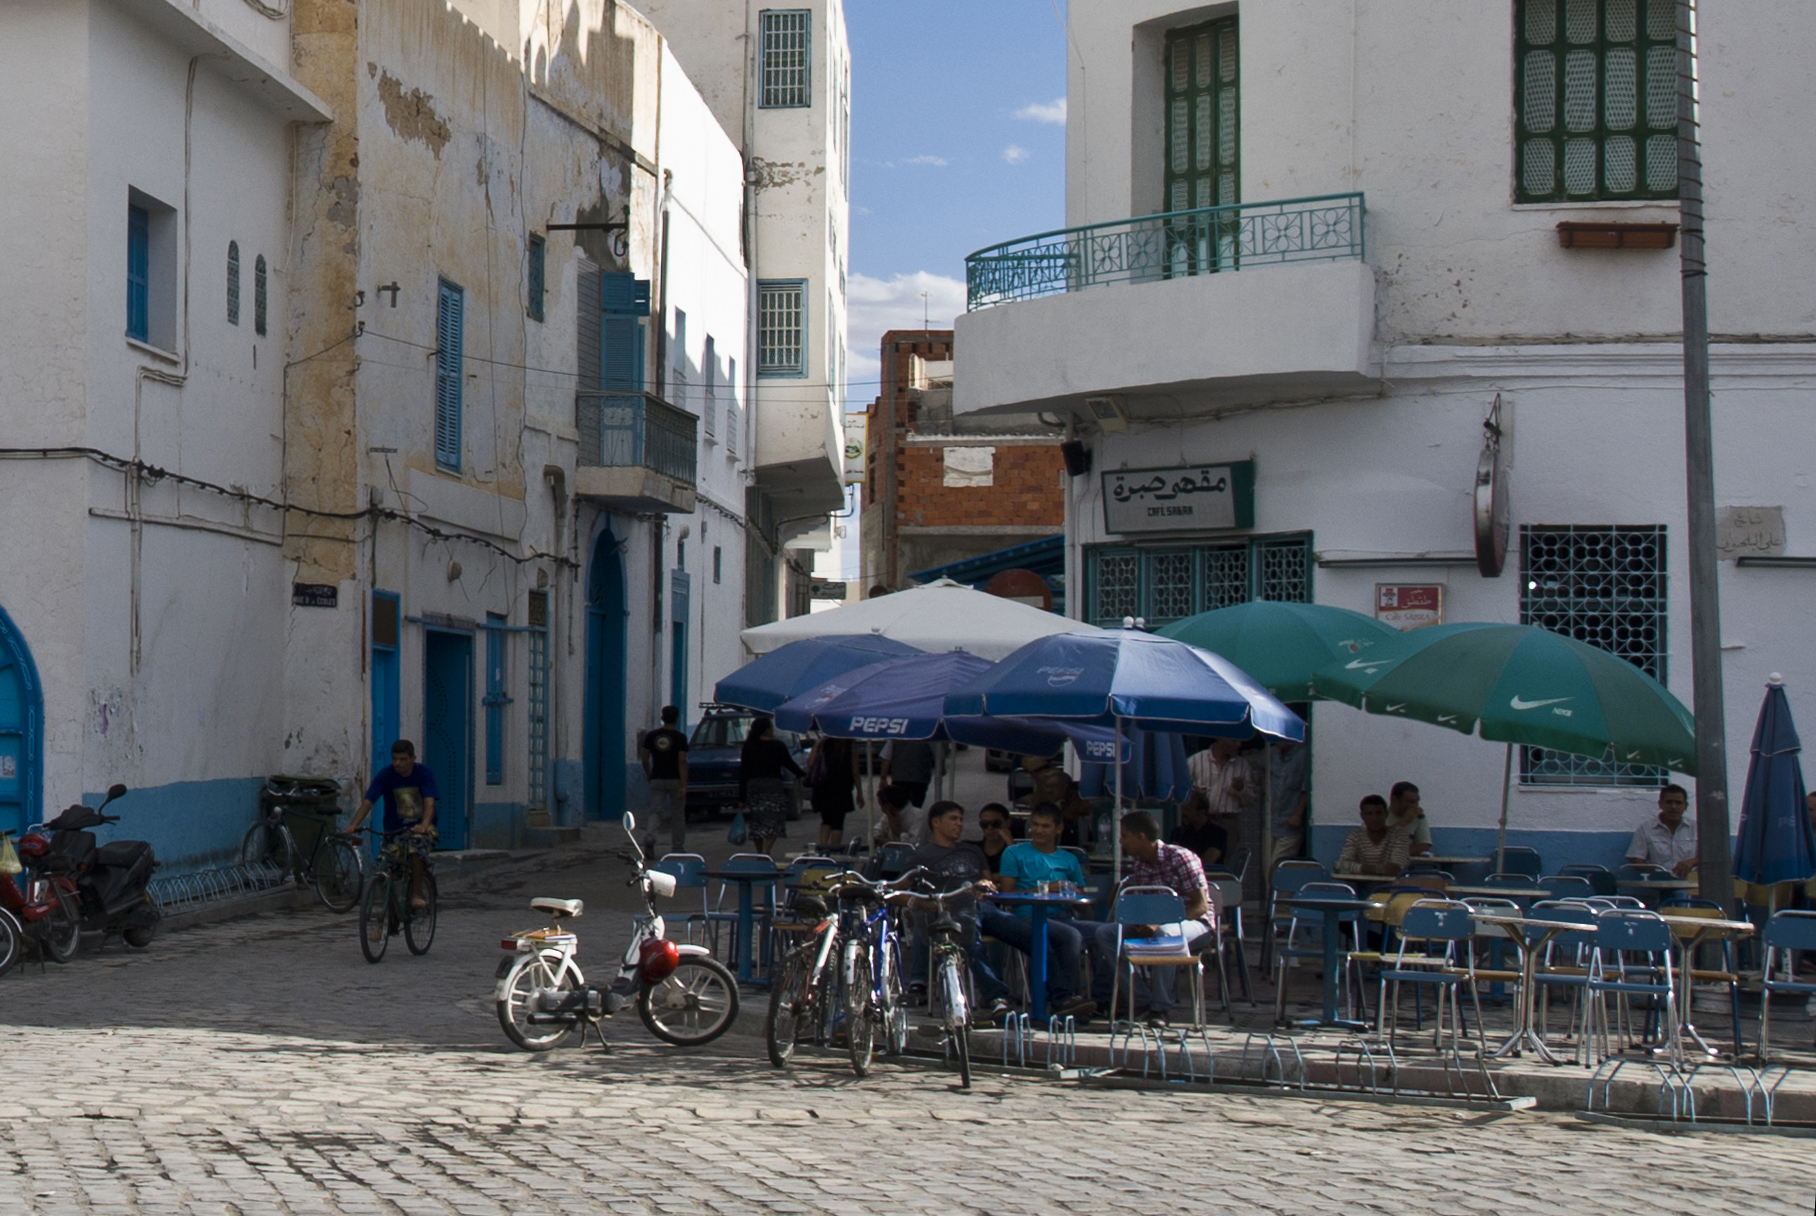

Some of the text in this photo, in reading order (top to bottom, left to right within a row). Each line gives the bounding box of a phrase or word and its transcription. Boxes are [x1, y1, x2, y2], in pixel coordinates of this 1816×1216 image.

[1113, 470, 1227, 503] مقهى صبرة
[848, 715, 909, 735] PEPSI
[1085, 739, 1116, 758] PEPSI
